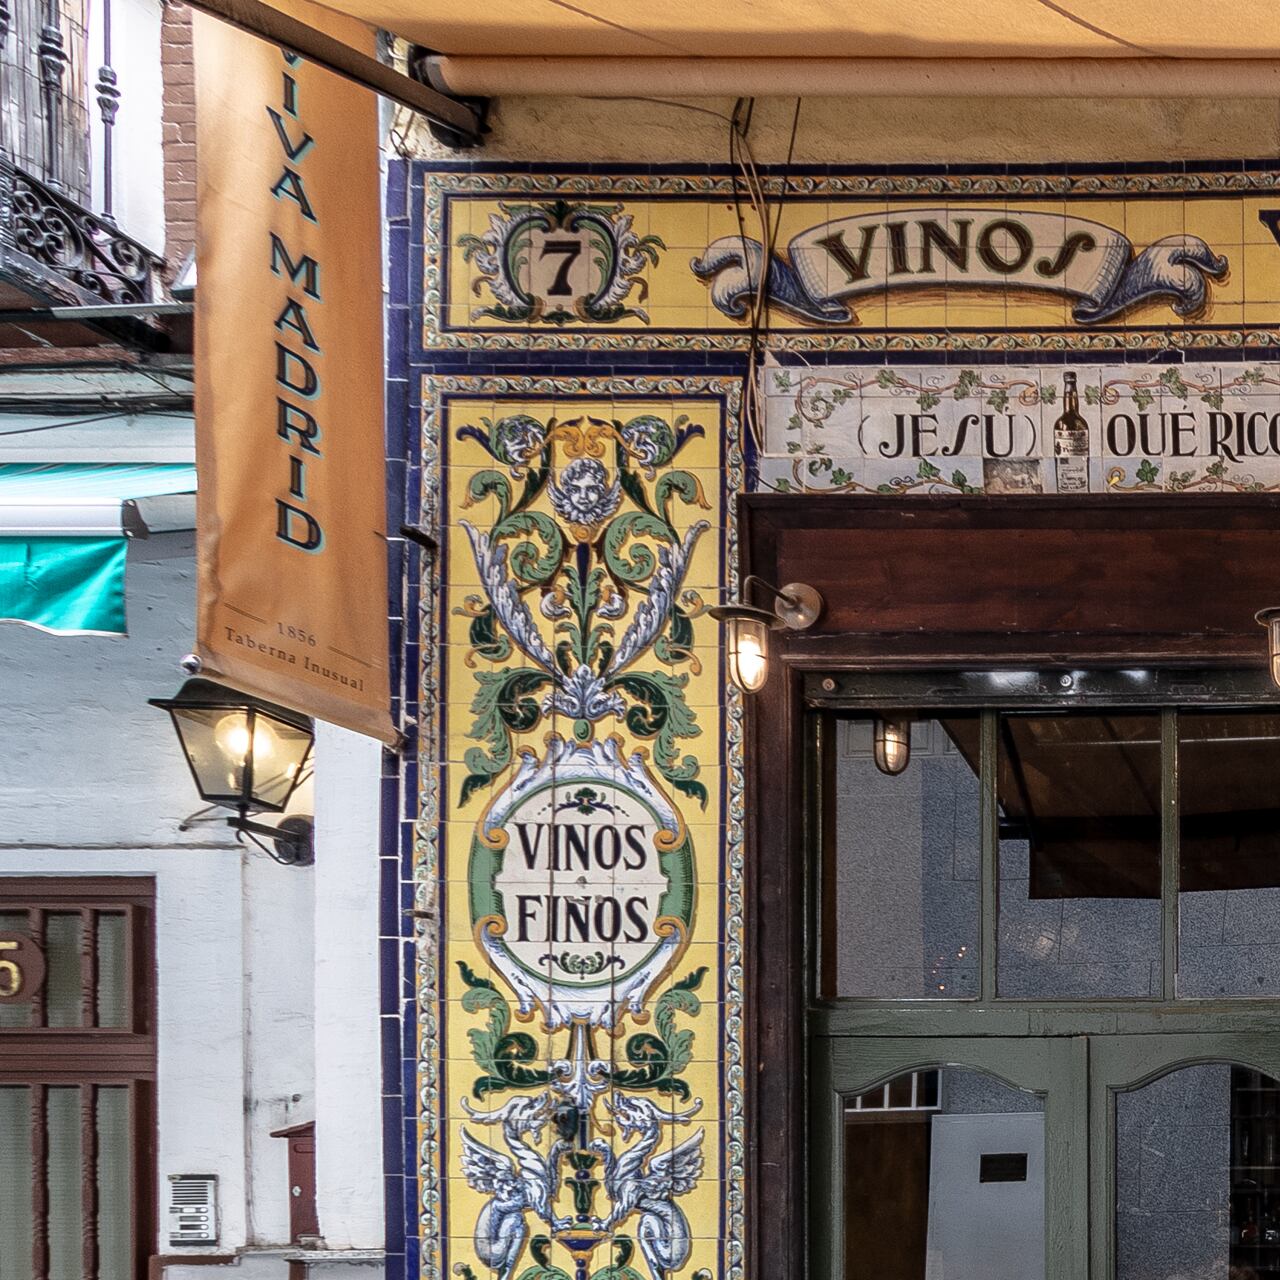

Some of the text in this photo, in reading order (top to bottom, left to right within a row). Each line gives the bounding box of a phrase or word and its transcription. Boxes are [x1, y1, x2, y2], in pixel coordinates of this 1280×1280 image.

[539, 240, 582, 296] 7
[812, 217, 1097, 285] VINOS
[269, 230, 325, 555] MADRID
[224, 626, 364, 692] Taberna Inusual
[277, 622, 317, 648] 1856
[514, 823, 648, 872] VINOS
[515, 894, 650, 944] FINOS
